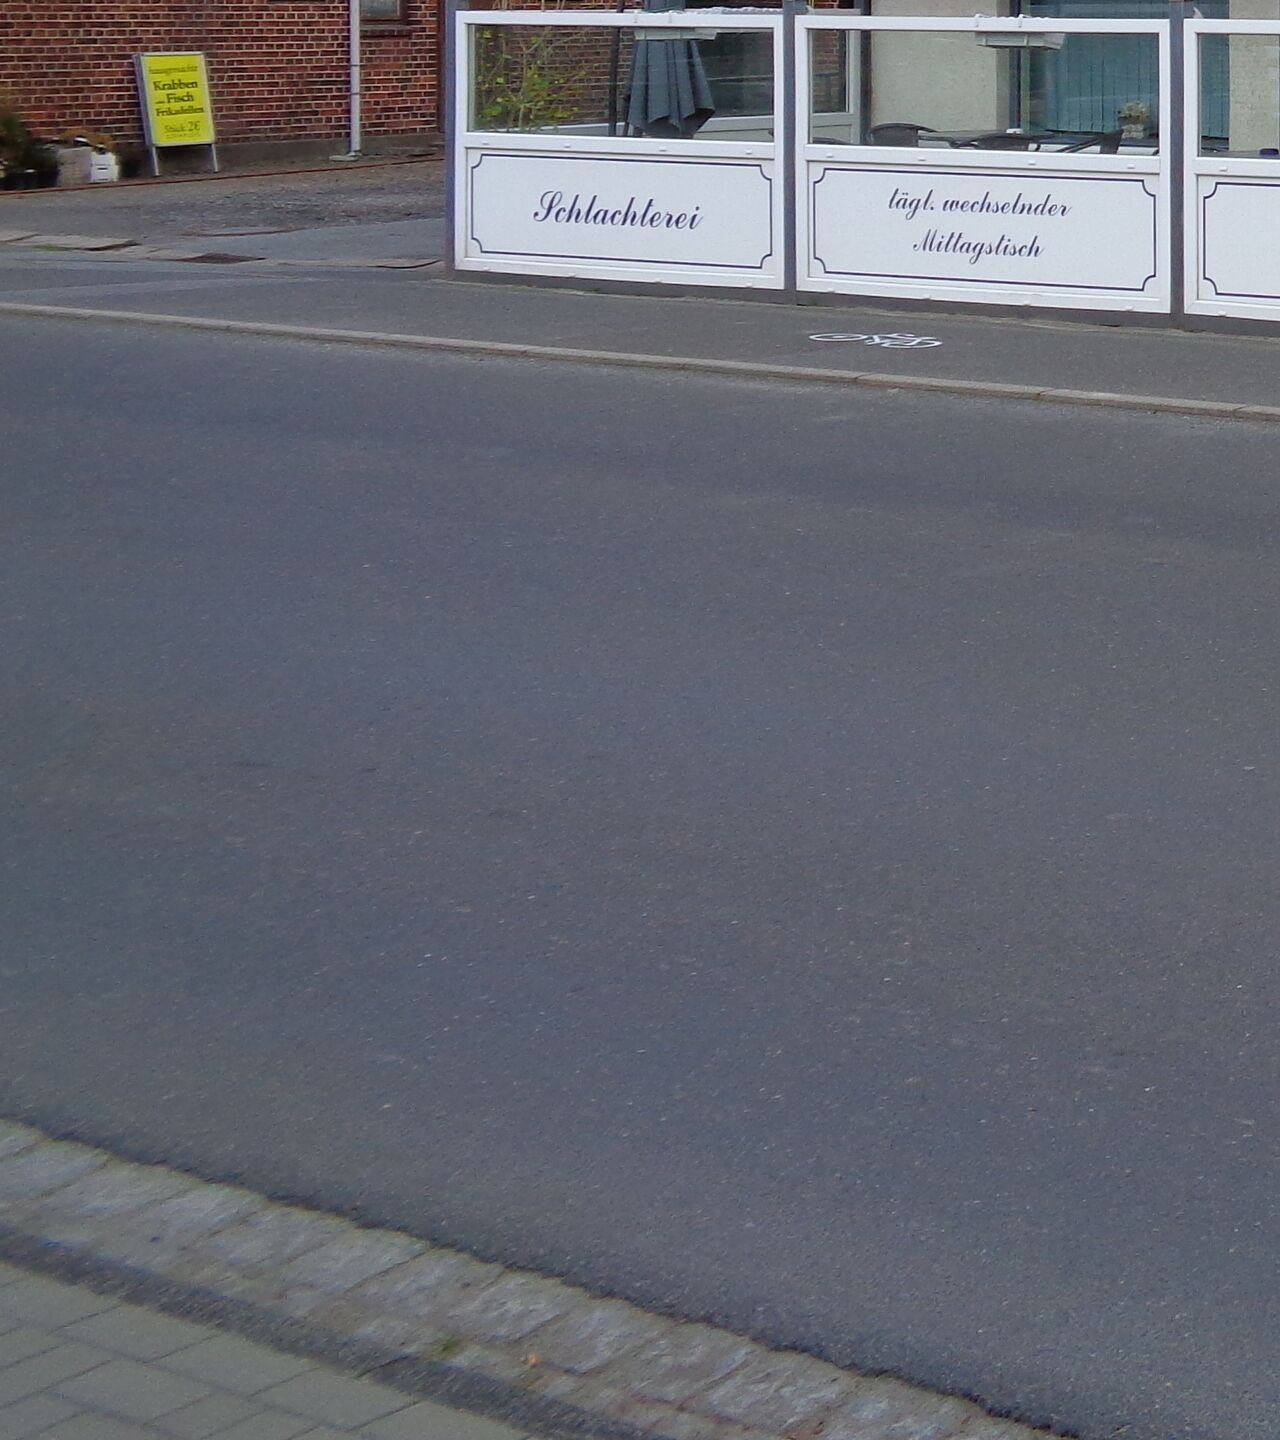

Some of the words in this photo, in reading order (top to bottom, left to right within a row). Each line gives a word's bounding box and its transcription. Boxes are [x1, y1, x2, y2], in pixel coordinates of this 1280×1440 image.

[153, 79, 198, 91] Krabben
[166, 92, 194, 103] Fisch
[533, 190, 703, 230] Schlachterei
[888, 188, 935, 220] tägl.
[942, 191, 1072, 216] wechselnder
[913, 228, 1044, 265] Mittagstisch
